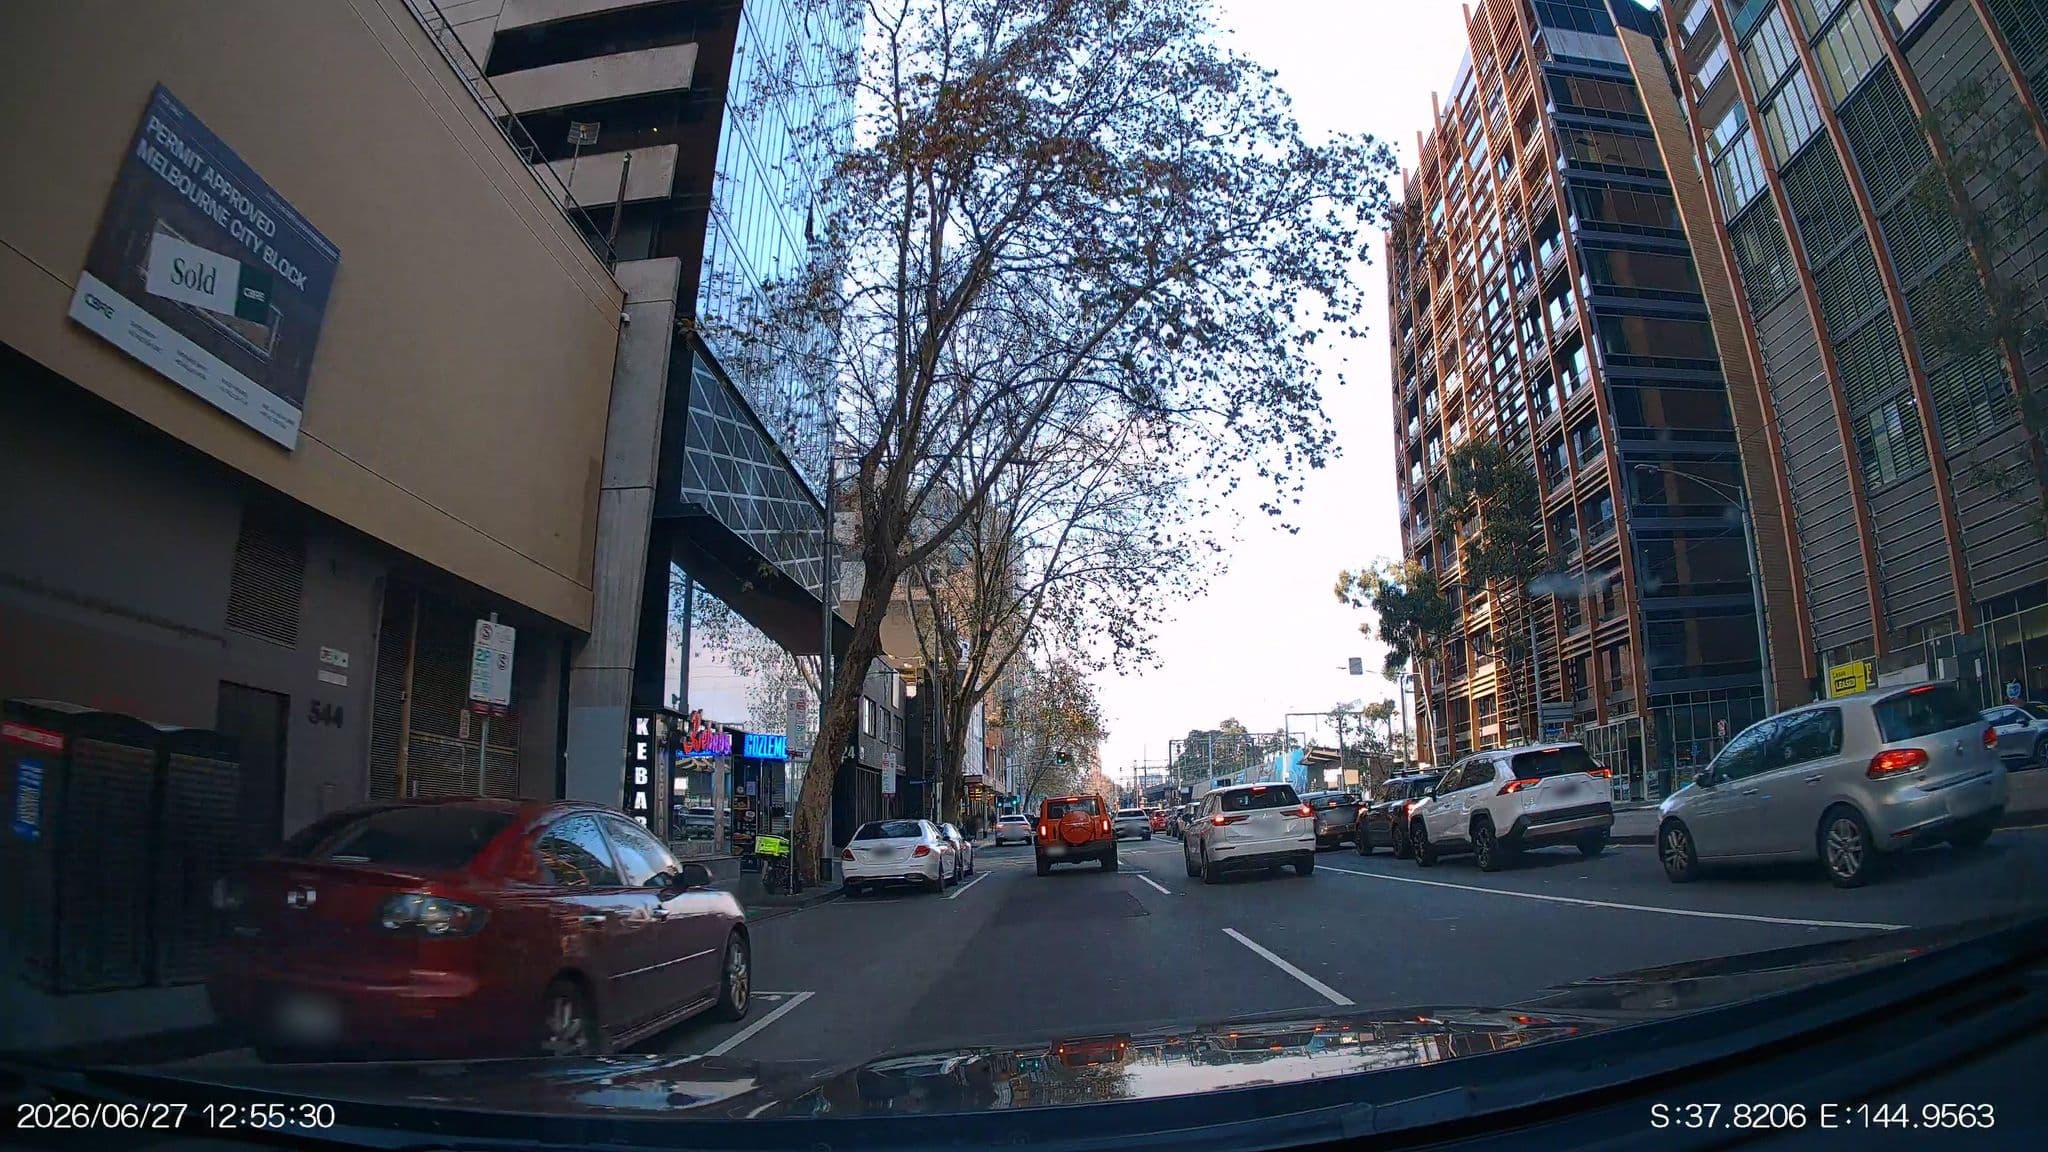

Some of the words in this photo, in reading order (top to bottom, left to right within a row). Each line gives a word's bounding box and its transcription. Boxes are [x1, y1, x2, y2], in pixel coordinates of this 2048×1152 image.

[135, 137, 229, 227] MELBOURNE
[229, 217, 264, 258] CITY
[262, 243, 307, 292] BLOCK
[146, 115, 204, 174] PERMIT
[201, 165, 276, 239] APPROVED
[170, 257, 217, 297] Sold
[308, 699, 344, 728] 544
